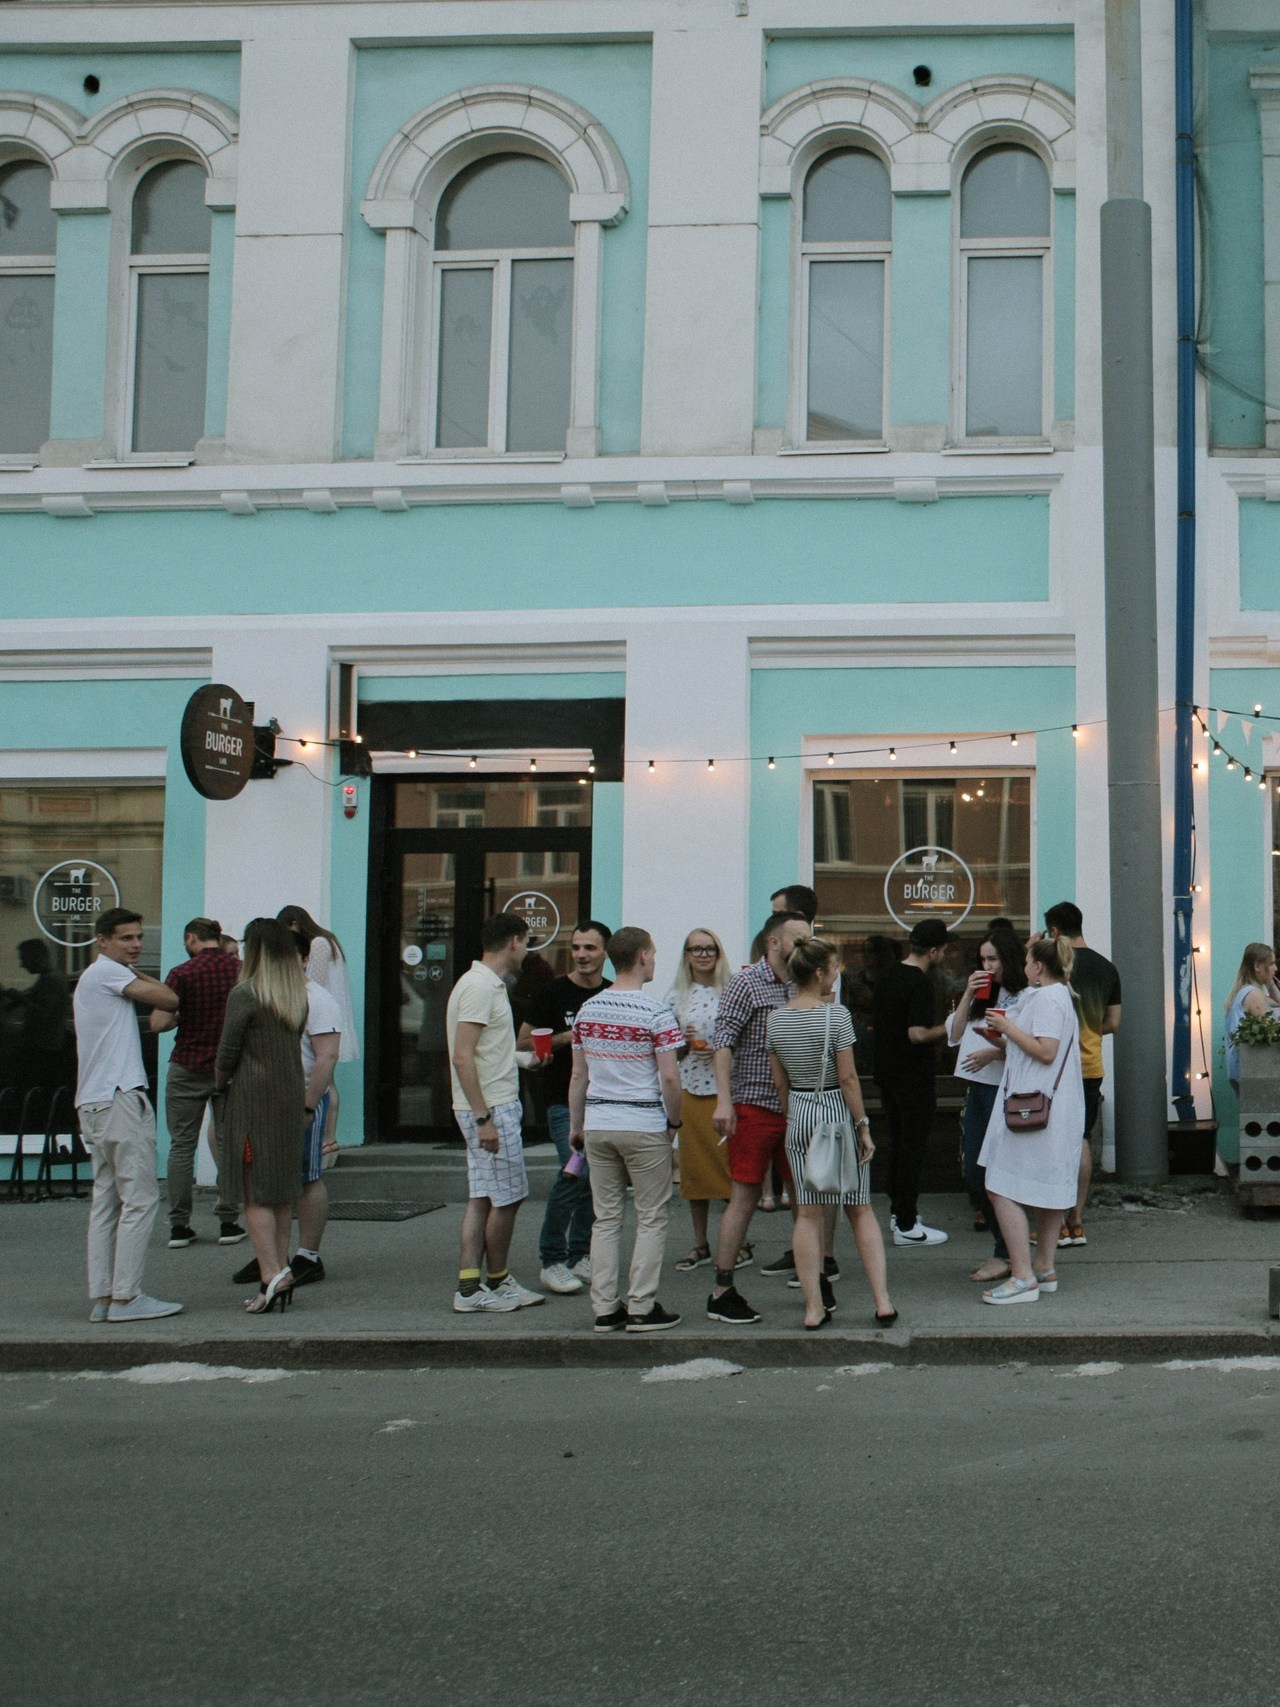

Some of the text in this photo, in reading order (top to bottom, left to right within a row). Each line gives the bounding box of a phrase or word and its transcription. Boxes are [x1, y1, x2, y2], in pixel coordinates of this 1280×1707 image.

[205, 730, 243, 757] BURGER
[903, 883, 955, 900] BURGER
[52, 896, 101, 912] BURGER
[522, 916, 548, 928] RGER
